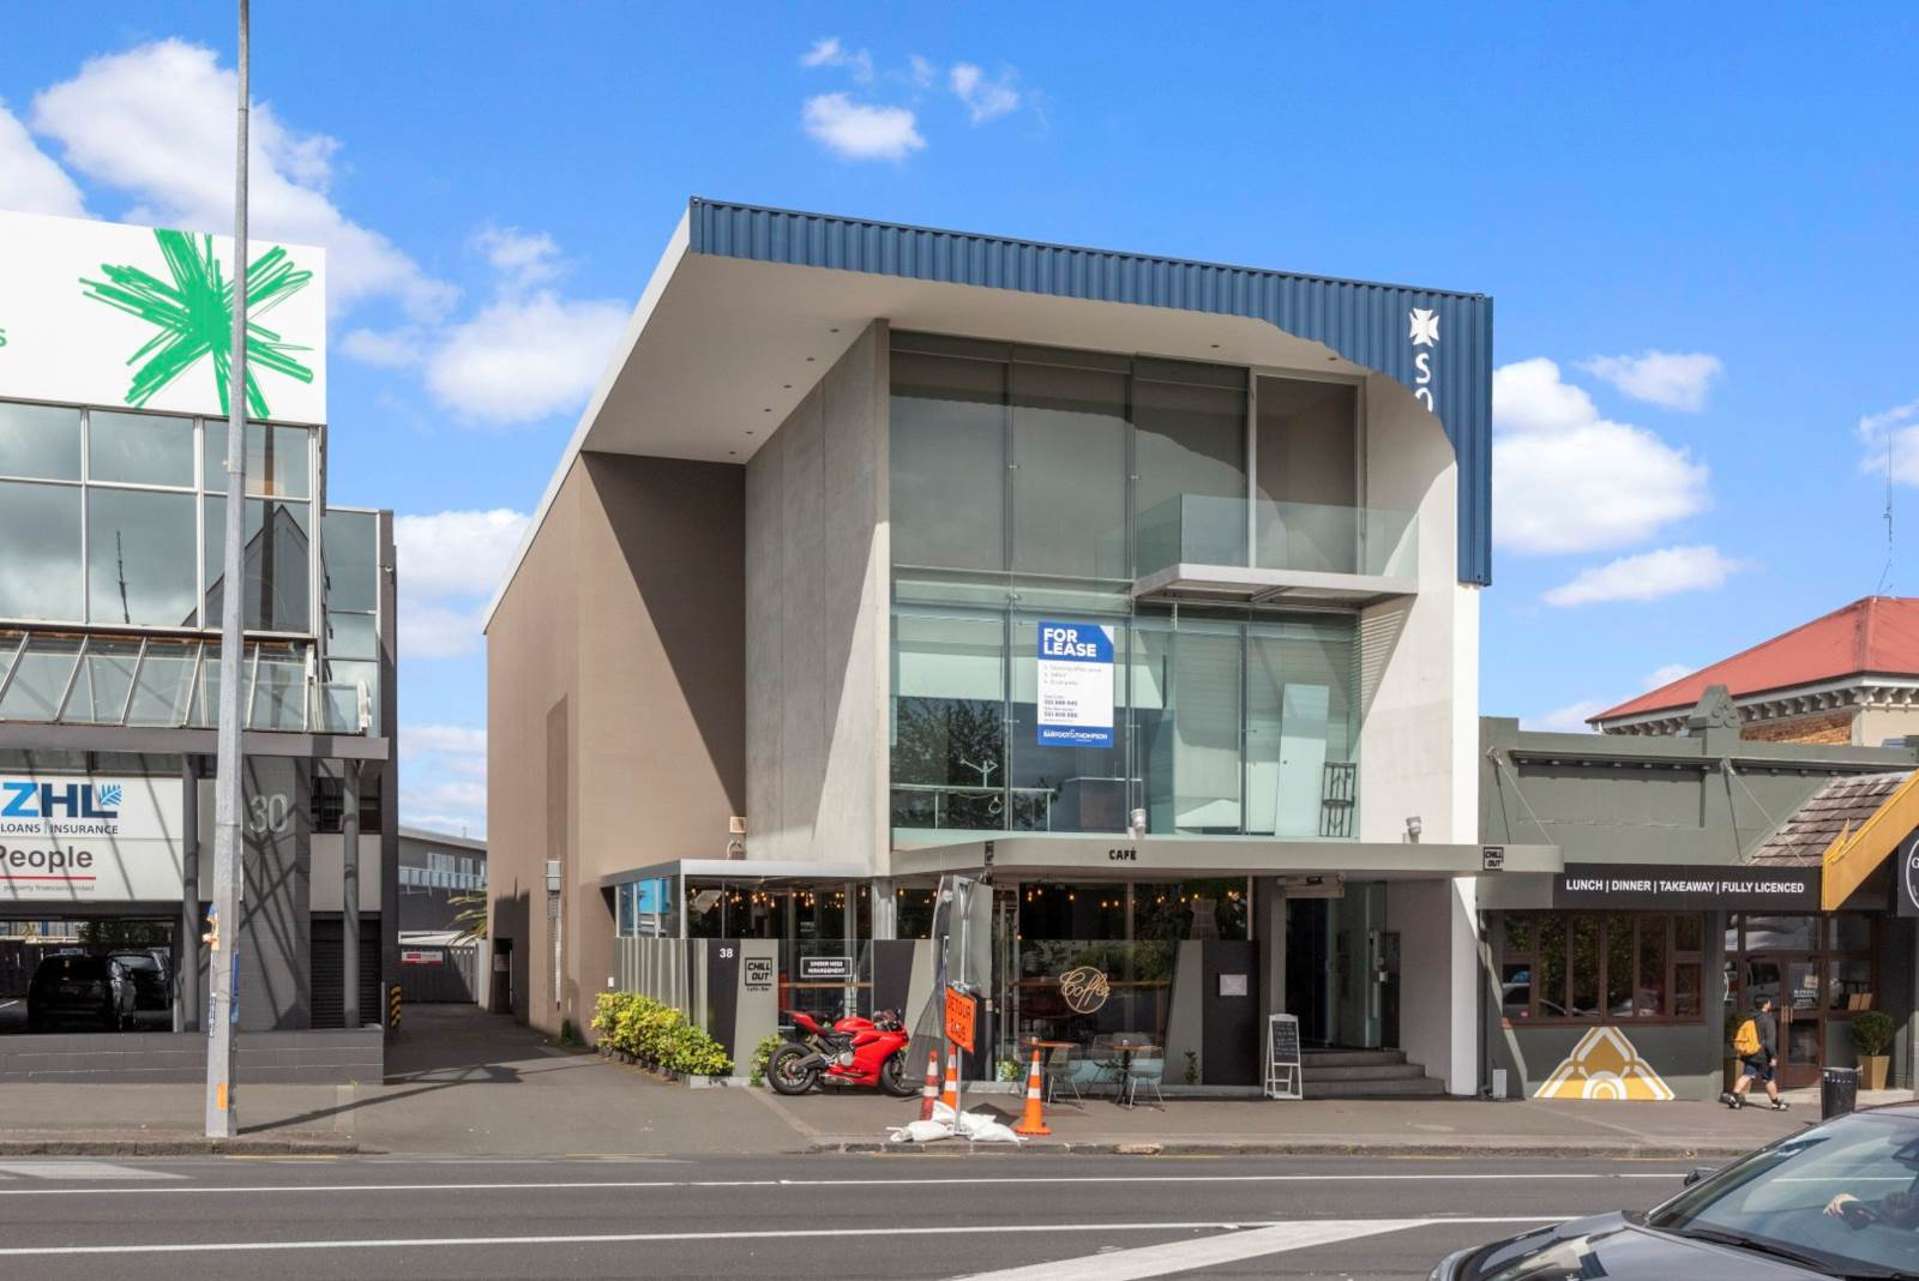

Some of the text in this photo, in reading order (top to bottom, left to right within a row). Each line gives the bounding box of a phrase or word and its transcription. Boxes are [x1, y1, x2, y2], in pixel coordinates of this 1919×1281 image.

[1043, 627, 1078, 643] FOR
[1043, 642, 1097, 657] LEASE
[1, 782, 118, 818] ZHL
[250, 794, 288, 832] 30
[0, 823, 118, 834] LOANS INSURANCE
[1565, 879, 1804, 893] LUNCH DINNER TAKEAWAY FULLY LICENCED
[719, 948, 733, 958] 38
[747, 962, 770, 971] CHILL
[751, 972, 768, 980] OUT
